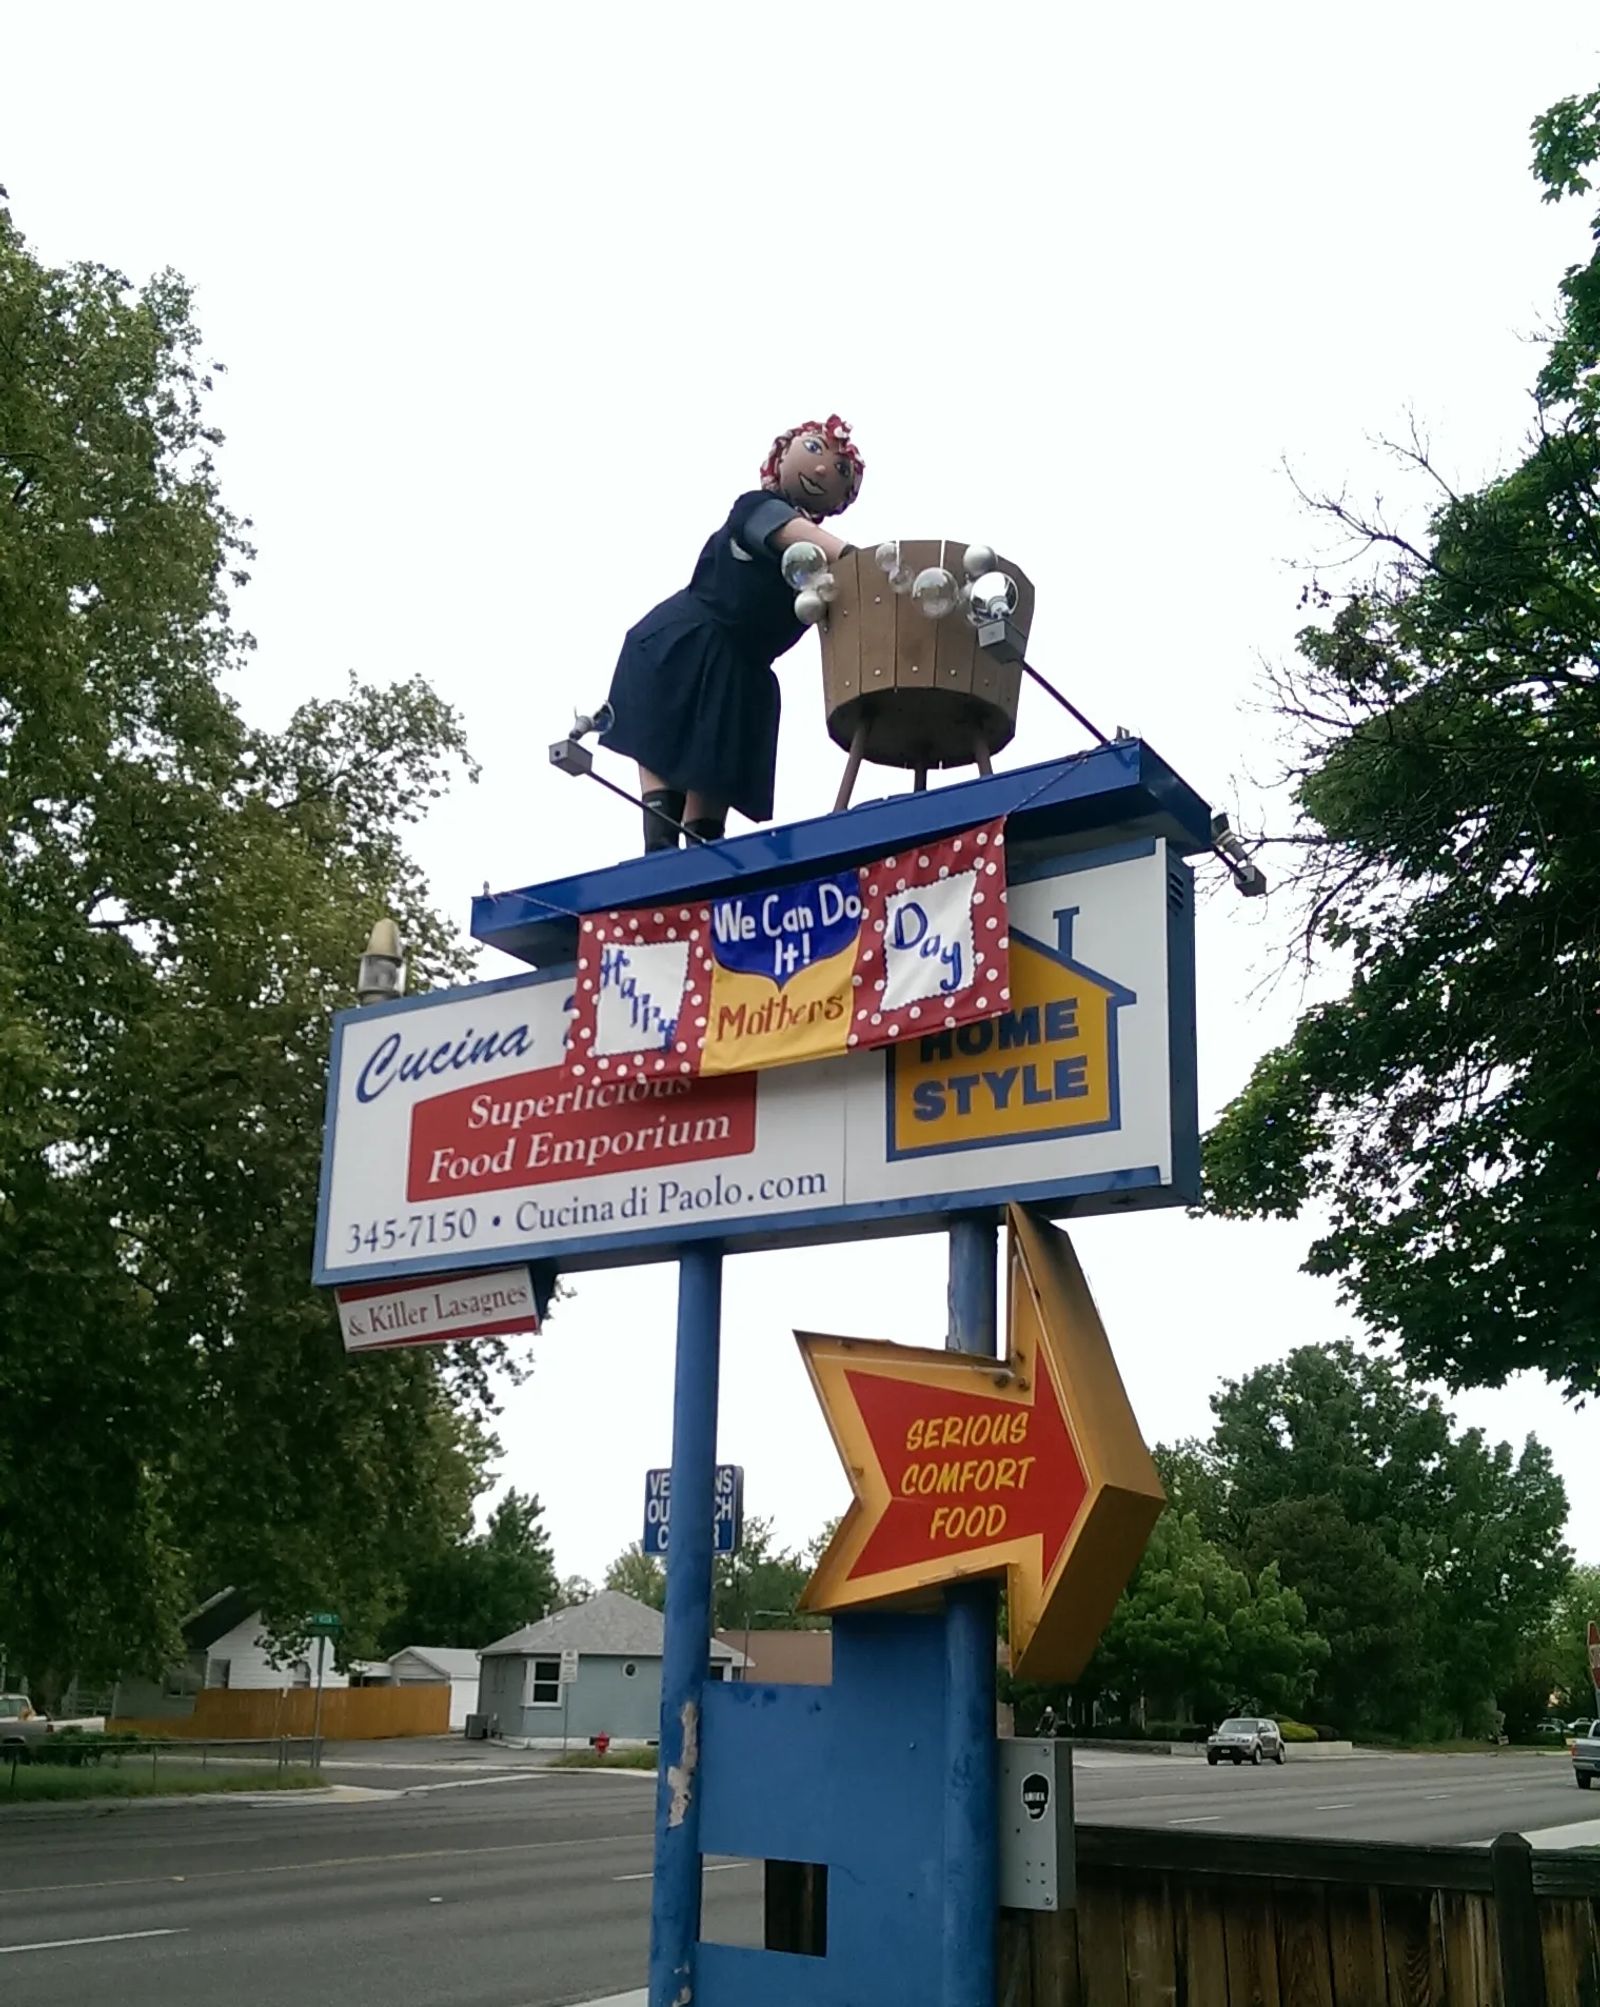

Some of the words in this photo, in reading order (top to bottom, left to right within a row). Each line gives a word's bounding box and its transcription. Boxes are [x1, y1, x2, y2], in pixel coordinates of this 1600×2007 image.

[713, 900, 756, 944] We
[762, 894, 815, 938] Can
[818, 882, 862, 928] Do
[774, 932, 811, 977] It!
[889, 901, 962, 992] Day
[600, 948, 679, 1053] Happy
[715, 994, 846, 1042] Mothers
[920, 997, 1080, 1063] HOME
[356, 1024, 535, 1104] Cucina
[912, 1055, 1089, 1122] STYLE
[467, 1076, 692, 1130] Superlicious
[427, 1137, 516, 1184] Food
[526, 1114, 732, 1168] Emporium
[346, 1206, 477, 1255] 345-7150
[349, 1310, 366, 1338] &
[368, 1298, 428, 1334] Killer
[434, 1285, 529, 1320] Lasagnes
[906, 1411, 1030, 1452] SERIOUS
[901, 1456, 1037, 1495] COMFORT
[929, 1504, 1007, 1540] FOOD
